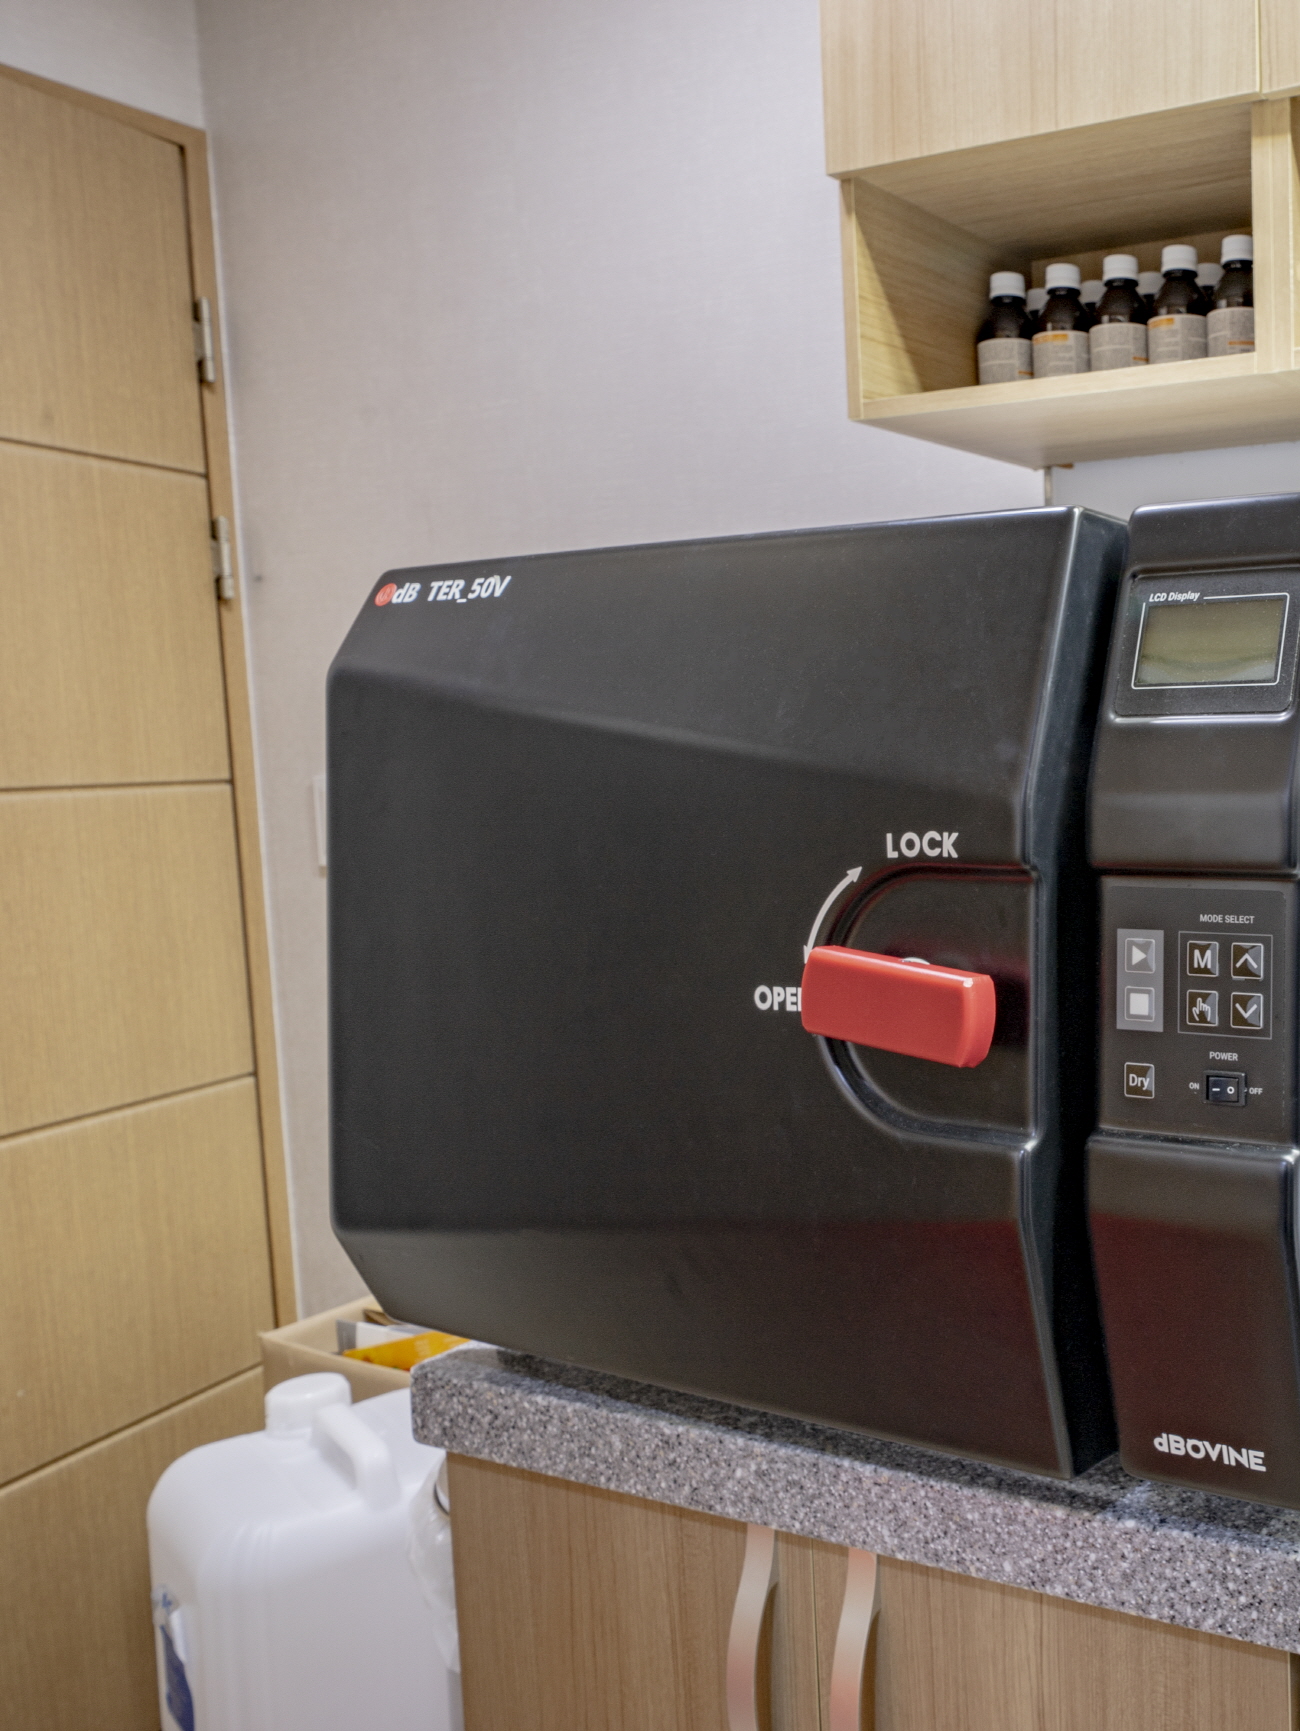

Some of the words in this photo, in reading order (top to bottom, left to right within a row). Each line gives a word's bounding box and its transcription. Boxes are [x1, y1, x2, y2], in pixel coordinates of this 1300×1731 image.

[427, 575, 512, 603] TER_50V
[1149, 592, 1167, 602] LCD
[1168, 591, 1200, 602] Display
[886, 831, 959, 858] LOCK
[1200, 914, 1223, 923] MODE
[1225, 915, 1255, 924] SELECT
[1193, 949, 1211, 968] M
[754, 985, 802, 1012] OPE
[1209, 1051, 1238, 1061] POWER
[1129, 1074, 1149, 1090] Dry
[1189, 1082, 1199, 1090] ON
[1249, 1087, 1263, 1095] OFF
[1153, 1432, 1267, 1472] dBOVINE
